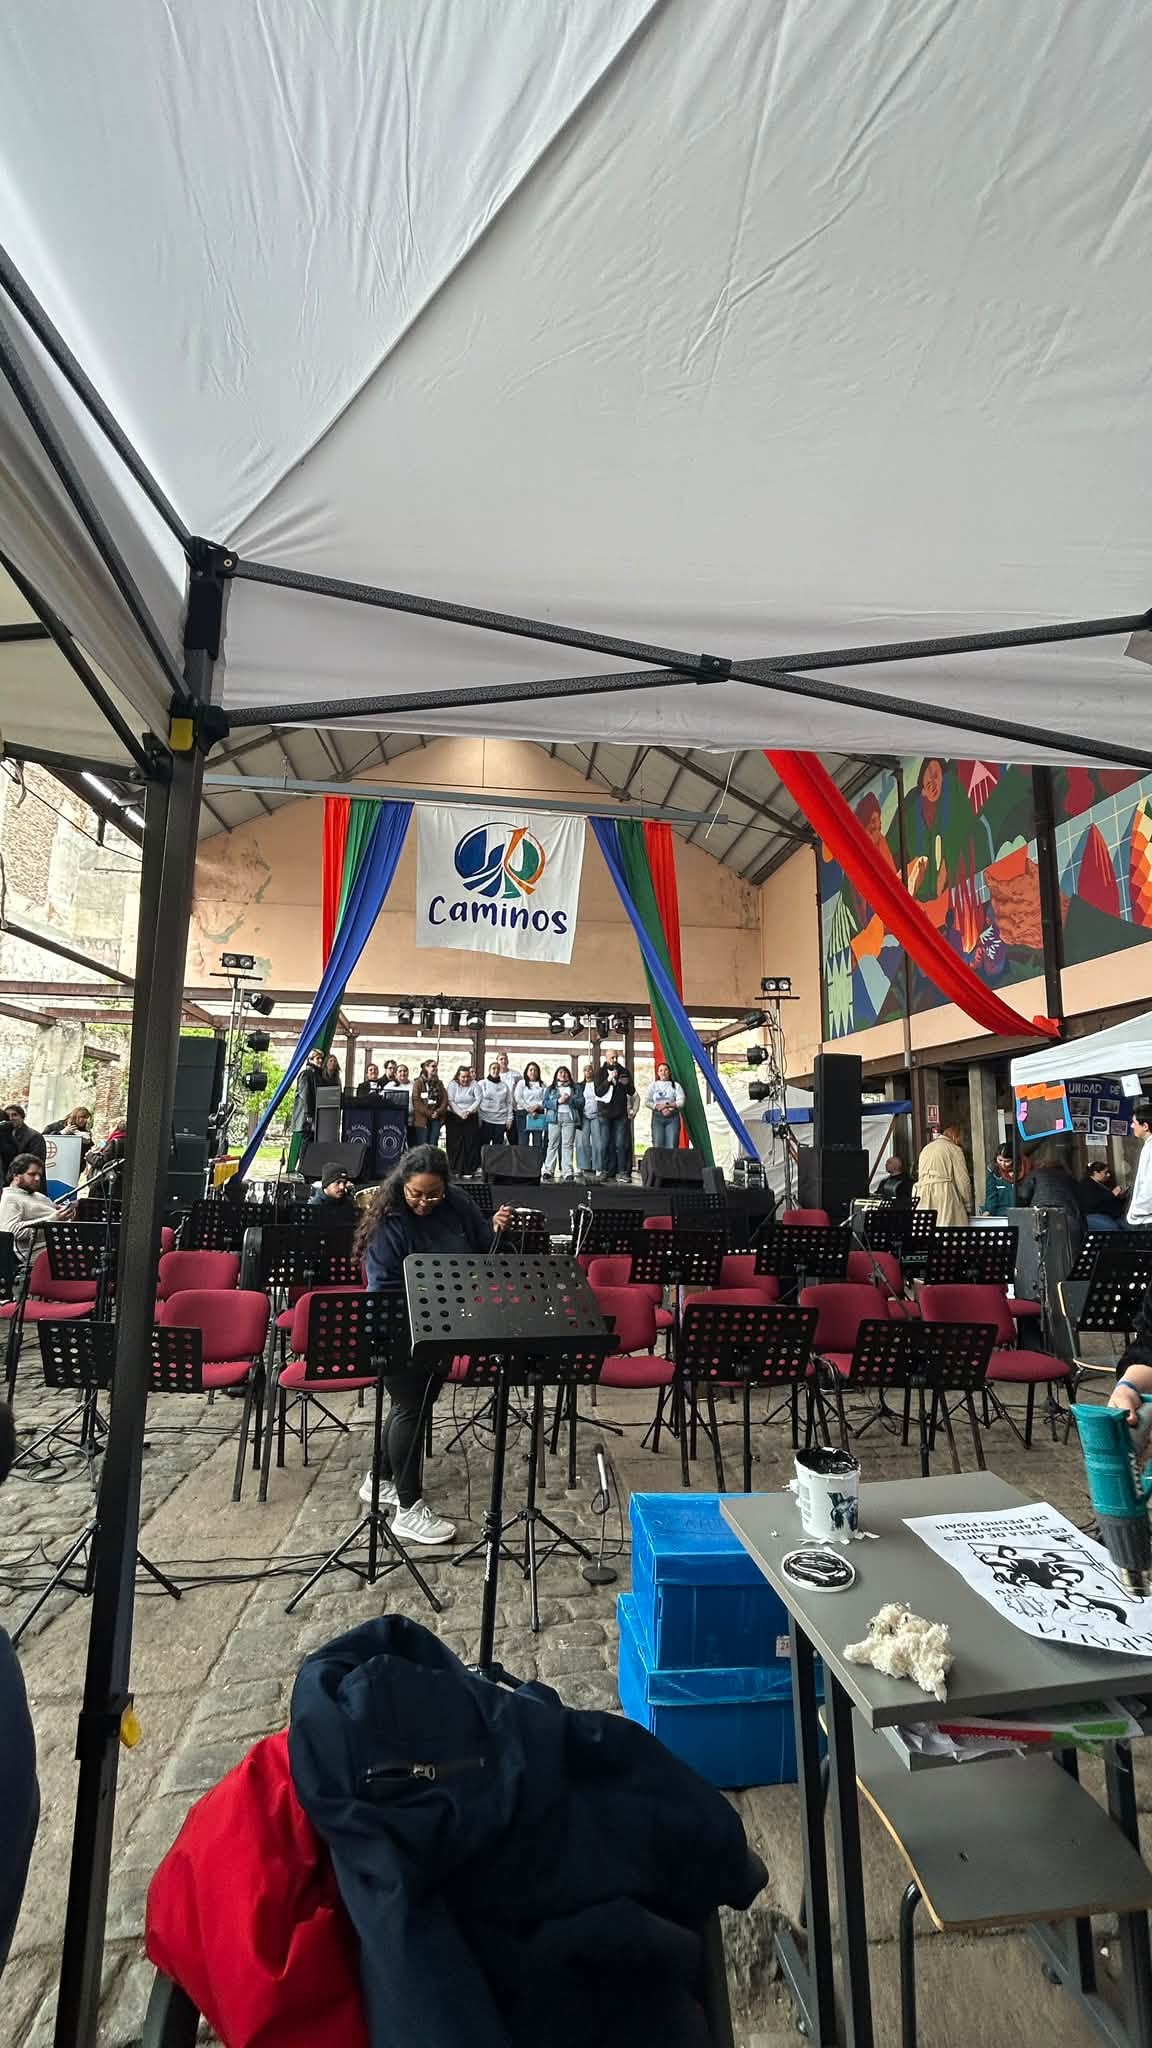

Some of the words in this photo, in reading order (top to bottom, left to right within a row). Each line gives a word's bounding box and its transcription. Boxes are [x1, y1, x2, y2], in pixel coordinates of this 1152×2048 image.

[428, 895, 568, 935] Caminos
[1068, 1082, 1102, 1095] UNIDAD
[980, 1518, 1025, 1527] PEDRO
[1008, 1527, 1068, 1537] ESCUELA
